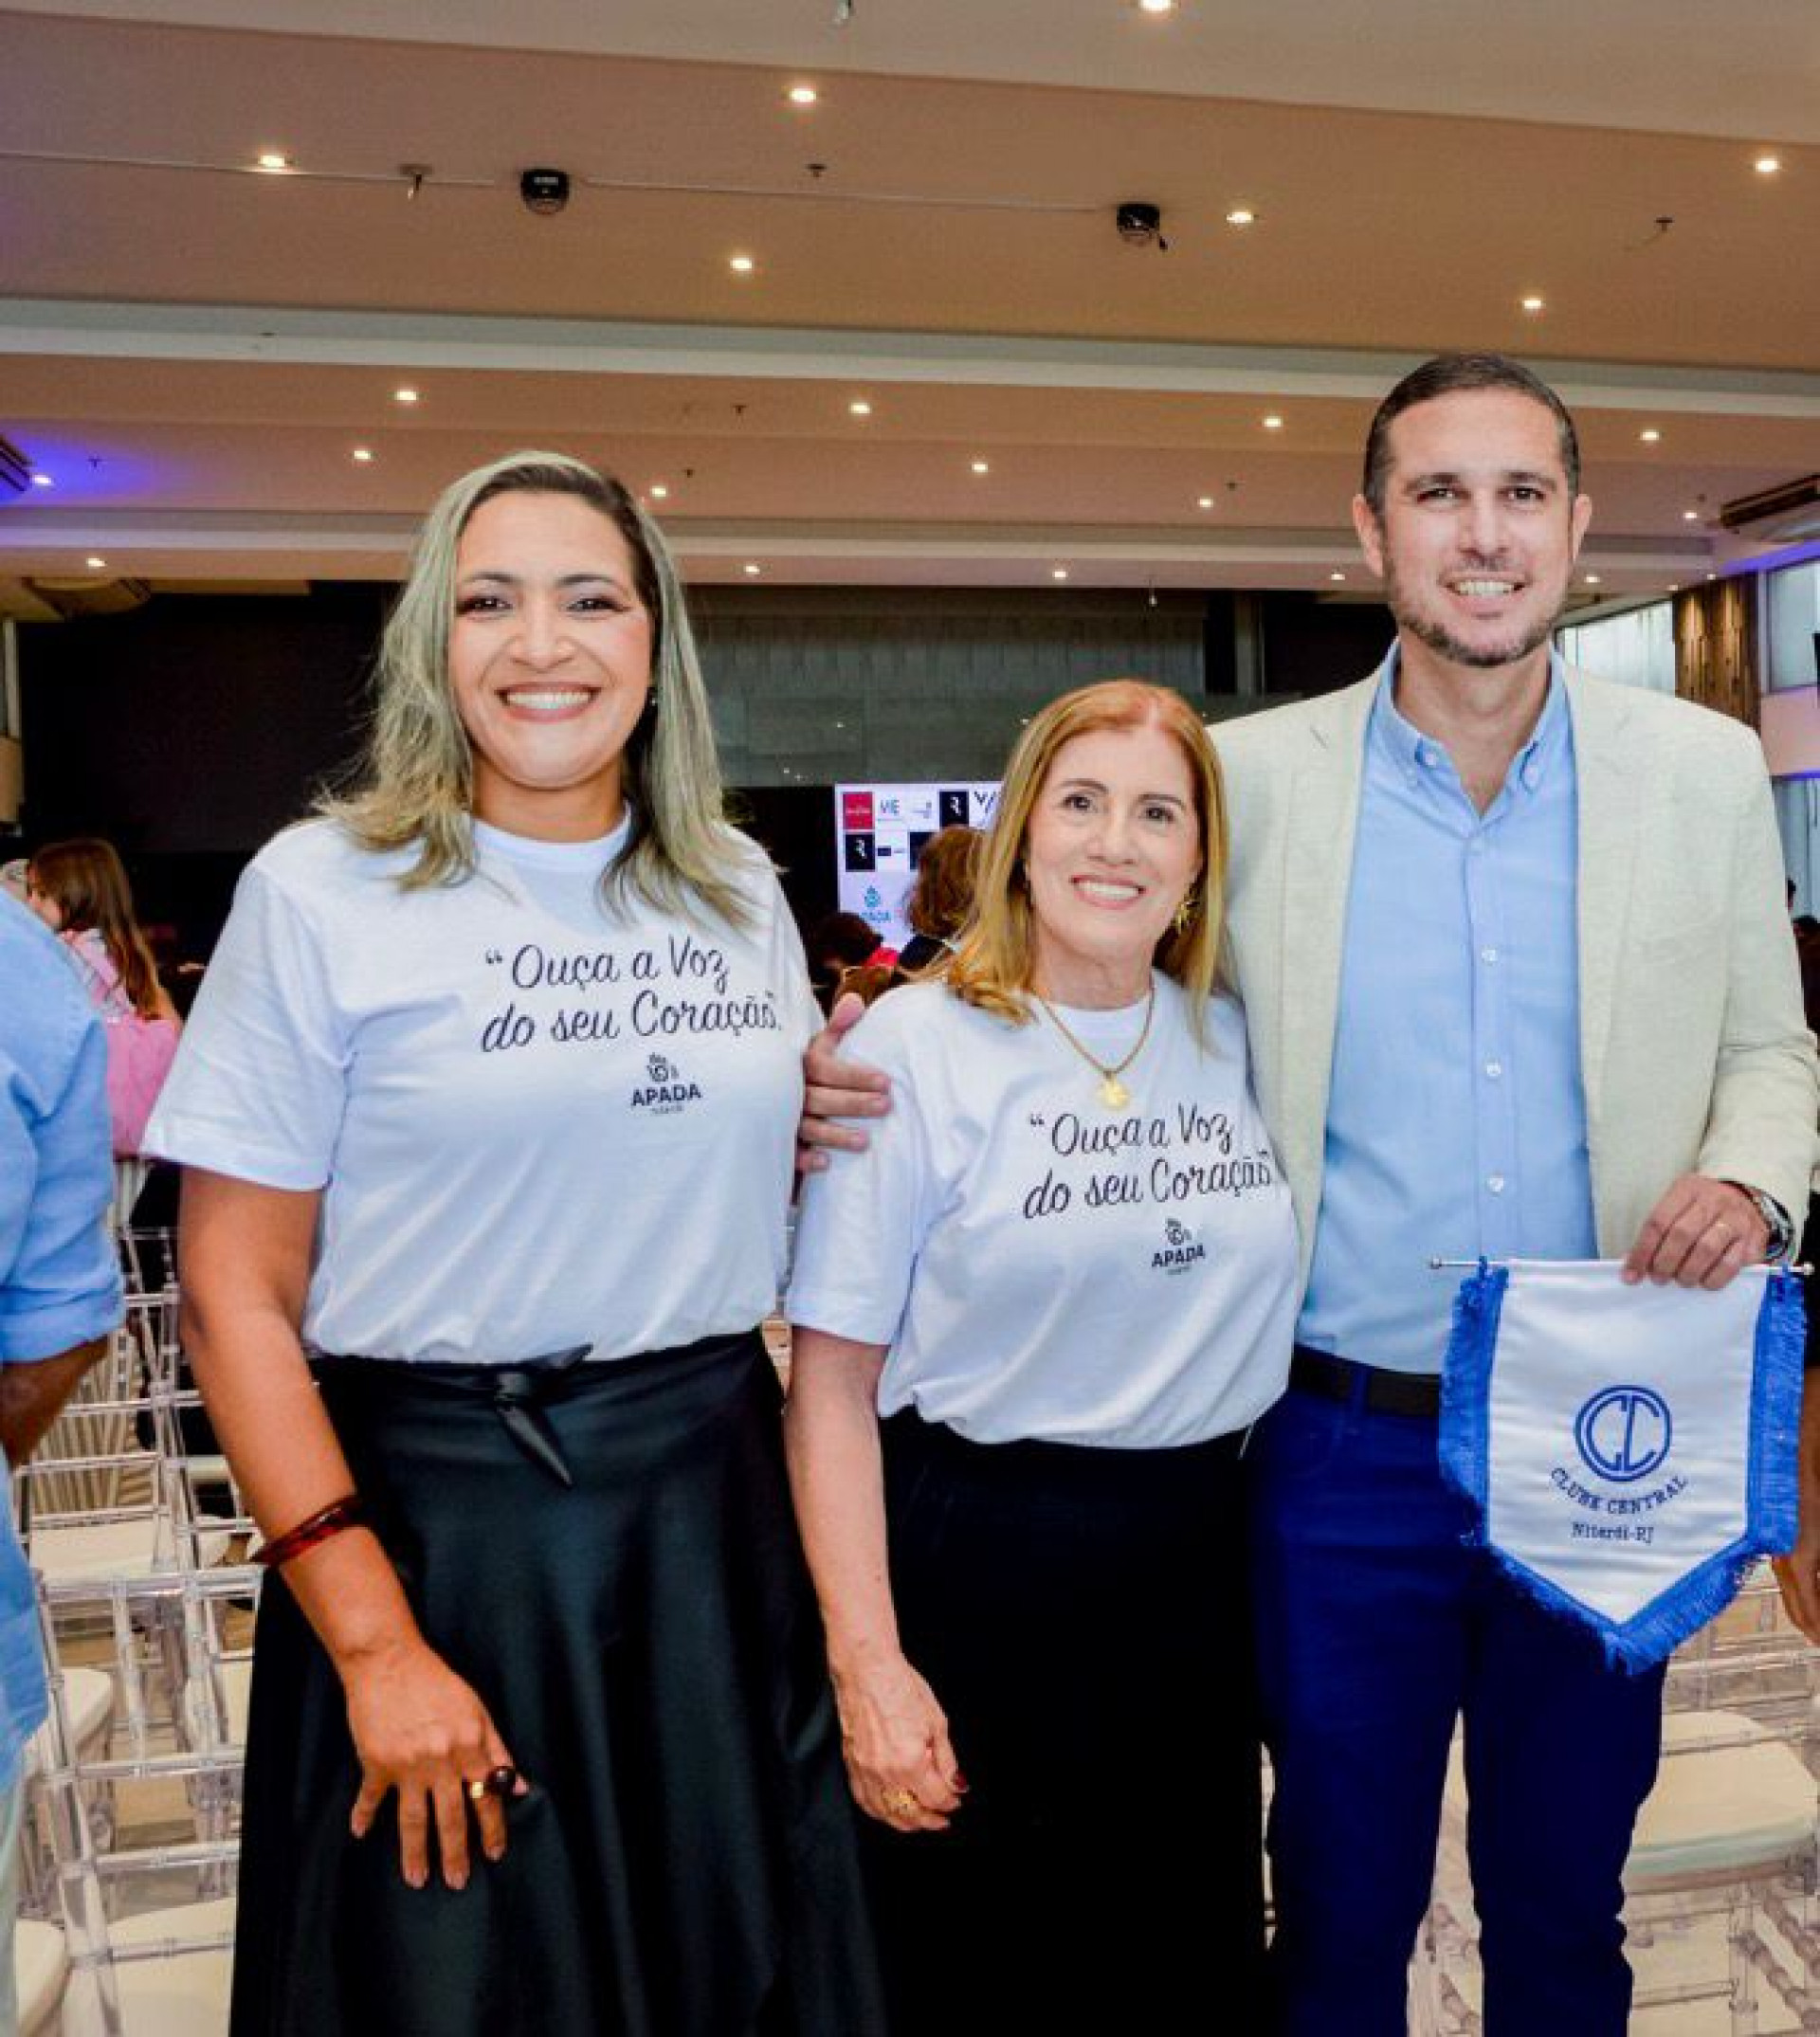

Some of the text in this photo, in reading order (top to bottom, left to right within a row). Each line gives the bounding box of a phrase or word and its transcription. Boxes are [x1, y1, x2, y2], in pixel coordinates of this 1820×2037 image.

[631, 951, 660, 980] a
[667, 934, 730, 995] Voz
[482, 1003, 536, 1053] do
[550, 1008, 621, 1043] seu
[631, 1083, 702, 1107] APADA
[1148, 1117, 1171, 1149] a
[1177, 1101, 1233, 1155] Voz
[1023, 1168, 1072, 1219] do
[1084, 1173, 1143, 1208] seu
[1152, 1244, 1206, 1268] APADA
[1551, 1466, 1688, 1515] CLUBE CENTRAL
